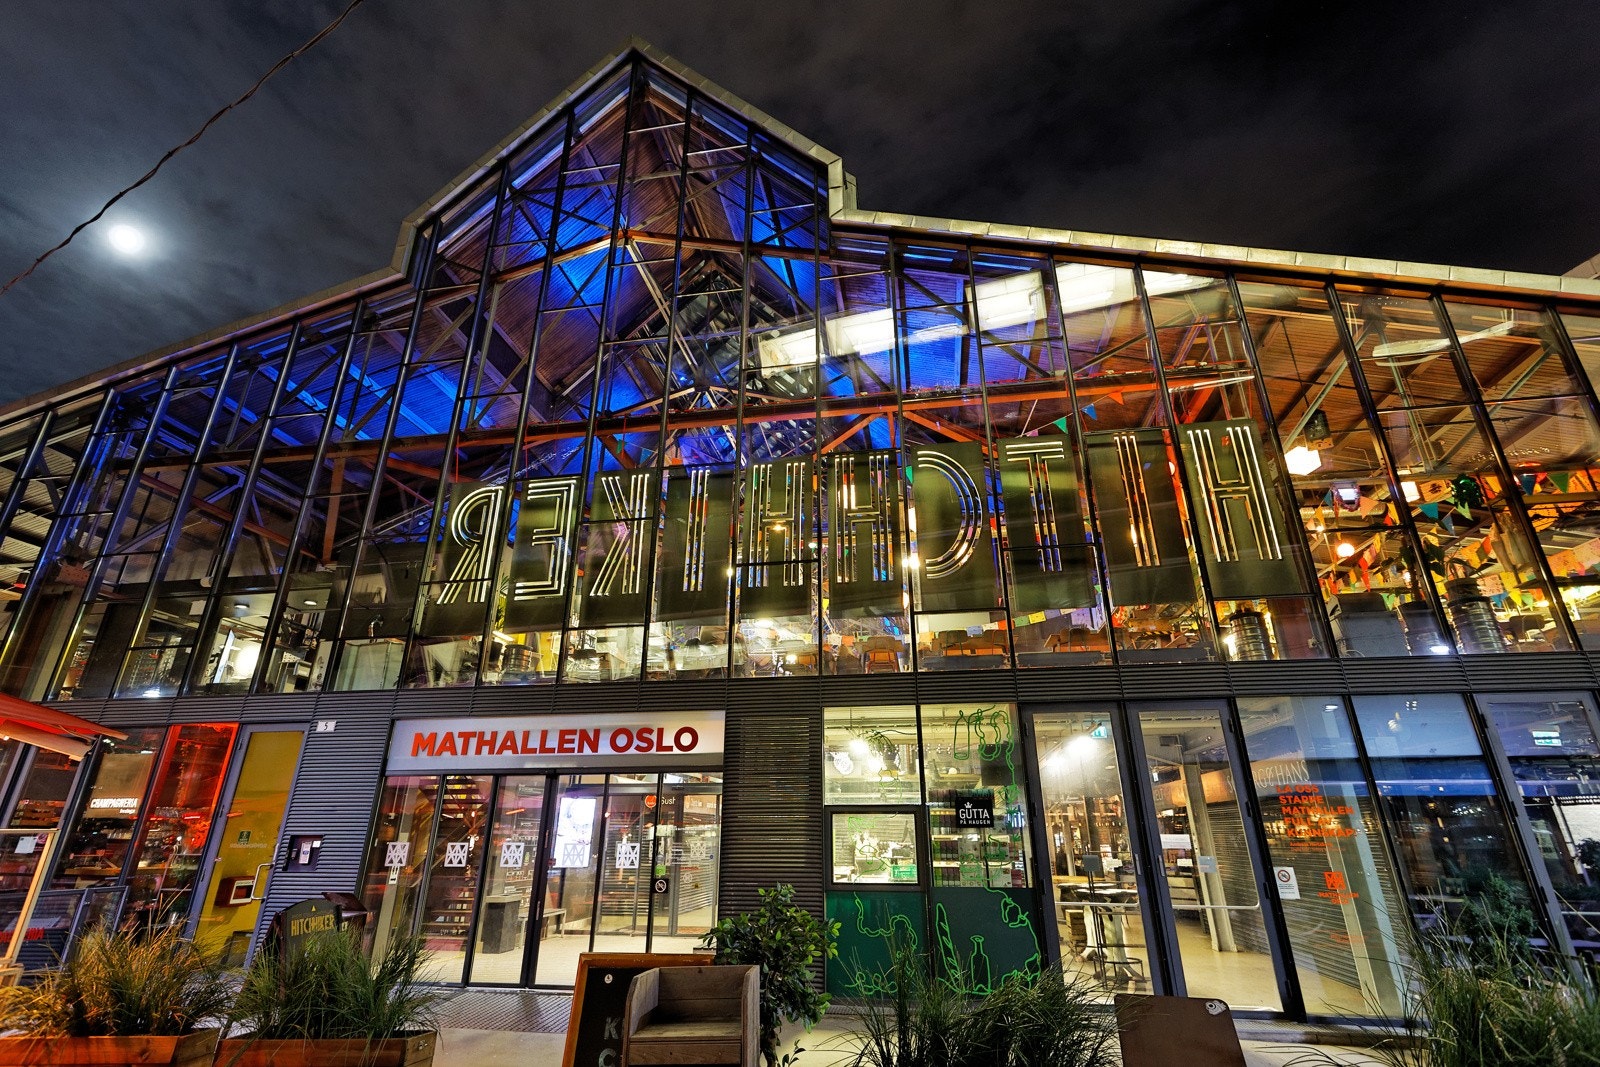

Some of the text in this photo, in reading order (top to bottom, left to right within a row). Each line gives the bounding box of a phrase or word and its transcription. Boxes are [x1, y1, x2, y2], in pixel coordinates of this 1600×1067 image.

[410, 726, 699, 757] MATHALLEN OSLO
[1276, 784, 1320, 793] LA OSS
[1279, 795, 1325, 804] STAPPE
[959, 808, 990, 819] GUTTA
[1281, 805, 1355, 815] MATHALLEN
[1284, 817, 1315, 826] FULL
